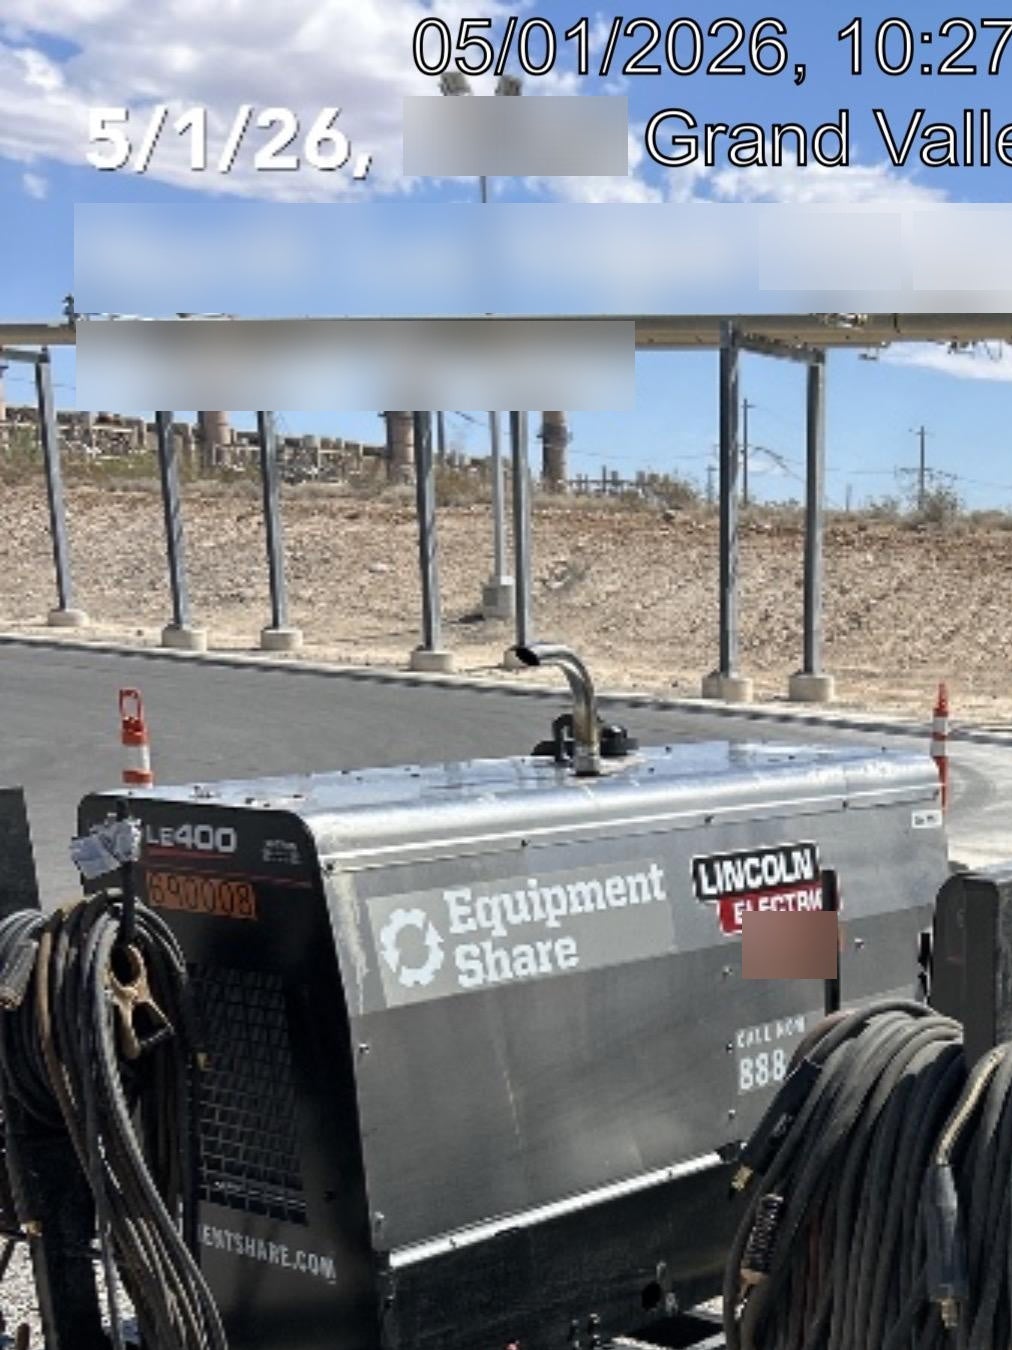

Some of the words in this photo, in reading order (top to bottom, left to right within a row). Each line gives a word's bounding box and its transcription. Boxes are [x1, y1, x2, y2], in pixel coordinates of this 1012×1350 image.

[146, 823, 238, 853] LE400
[699, 848, 815, 896] LINCOLN
[443, 863, 667, 937] Equipment
[455, 935, 580, 988] Share
